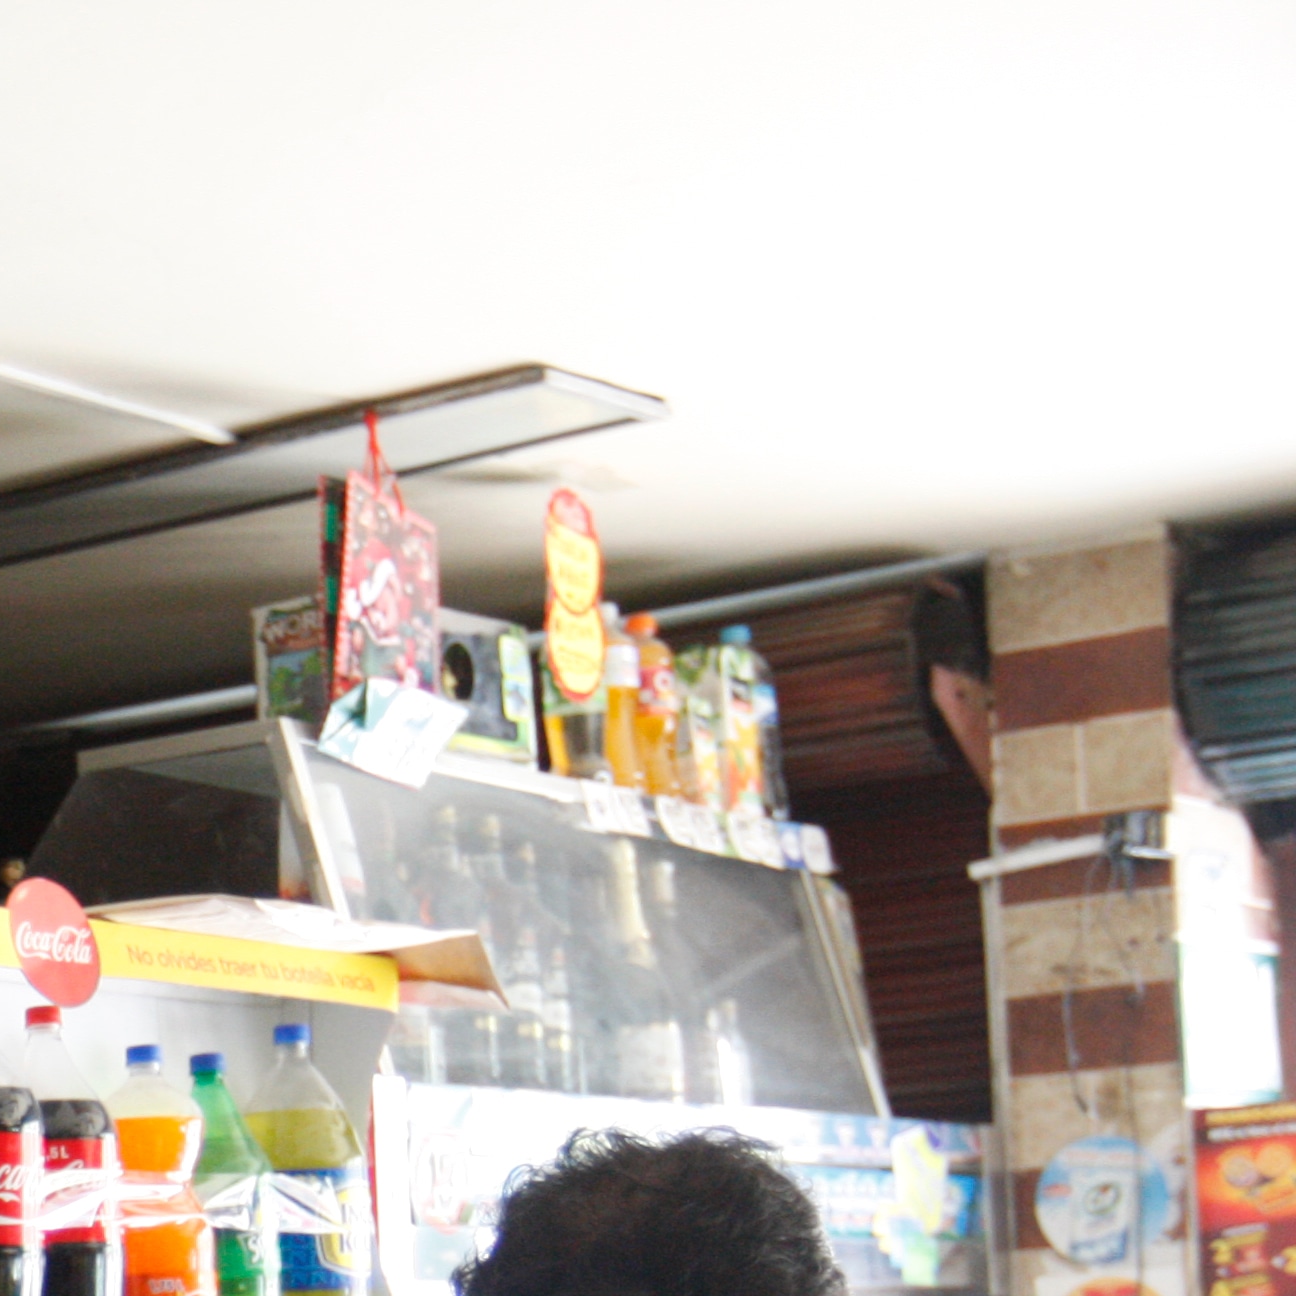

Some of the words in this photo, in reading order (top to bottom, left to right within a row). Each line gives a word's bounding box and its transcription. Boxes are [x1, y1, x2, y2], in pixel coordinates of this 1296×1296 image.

[15, 920, 93, 965] Coca-Cola
[126, 944, 154, 967] No
[157, 949, 216, 973] olvides
[219, 957, 257, 977] traer
[260, 963, 279, 979] tu
[282, 965, 334, 986] botella
[338, 972, 376, 992] vacía
